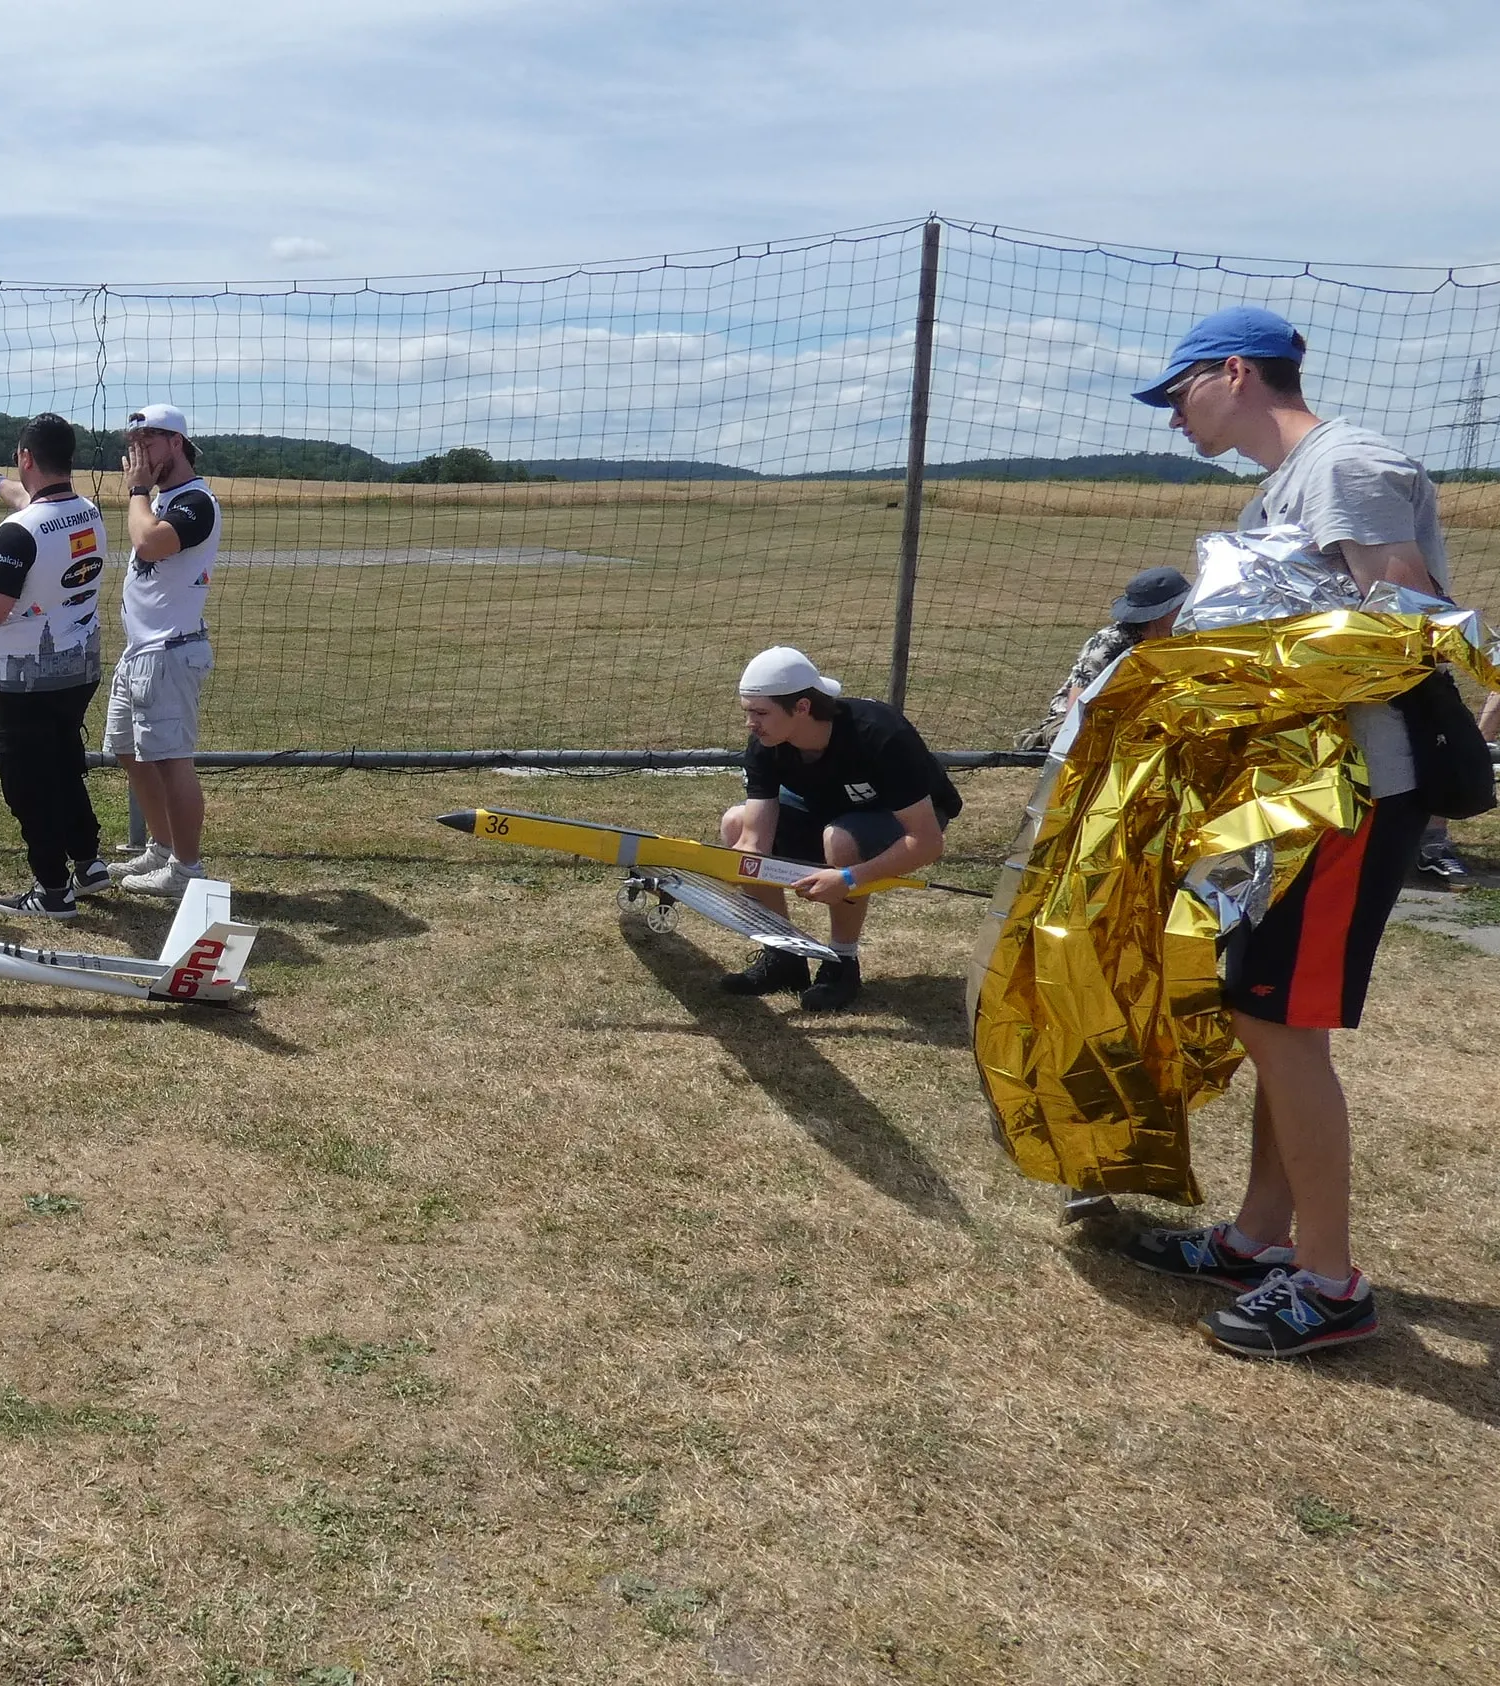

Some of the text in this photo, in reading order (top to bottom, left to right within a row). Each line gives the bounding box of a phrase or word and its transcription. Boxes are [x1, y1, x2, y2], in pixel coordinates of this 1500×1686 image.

[40, 511, 90, 535] GUILLERMO
[485, 815, 509, 836] 36
[169, 939, 226, 998] 26
